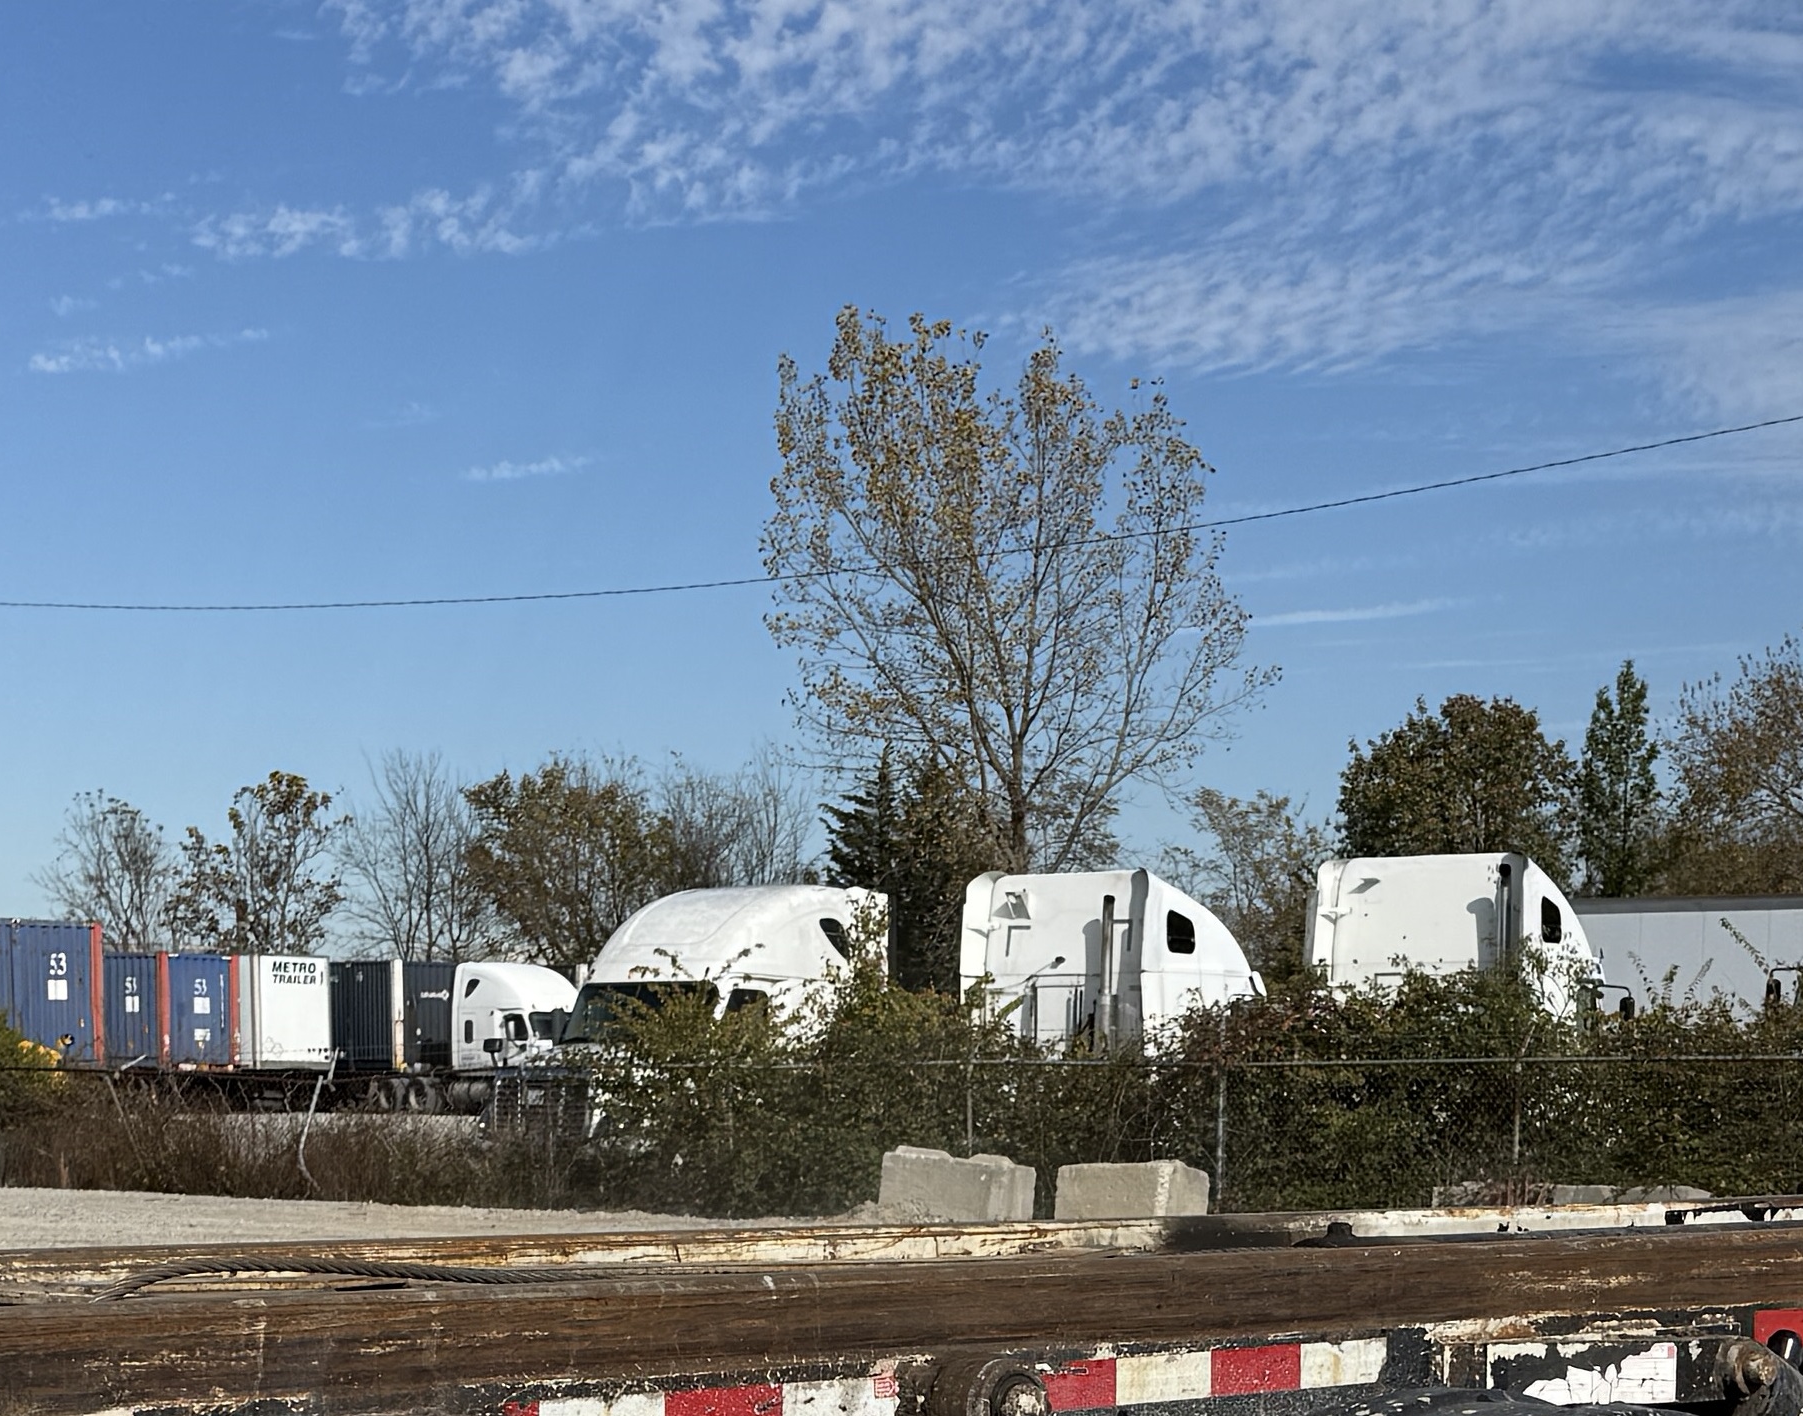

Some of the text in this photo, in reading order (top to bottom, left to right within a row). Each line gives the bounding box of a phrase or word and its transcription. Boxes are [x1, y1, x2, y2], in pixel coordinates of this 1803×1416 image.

[49, 952, 67, 976] 53
[272, 961, 316, 974] METRO
[125, 976, 138, 994] 53
[194, 978, 207, 995] 53
[273, 974, 316, 984] TRAILER
